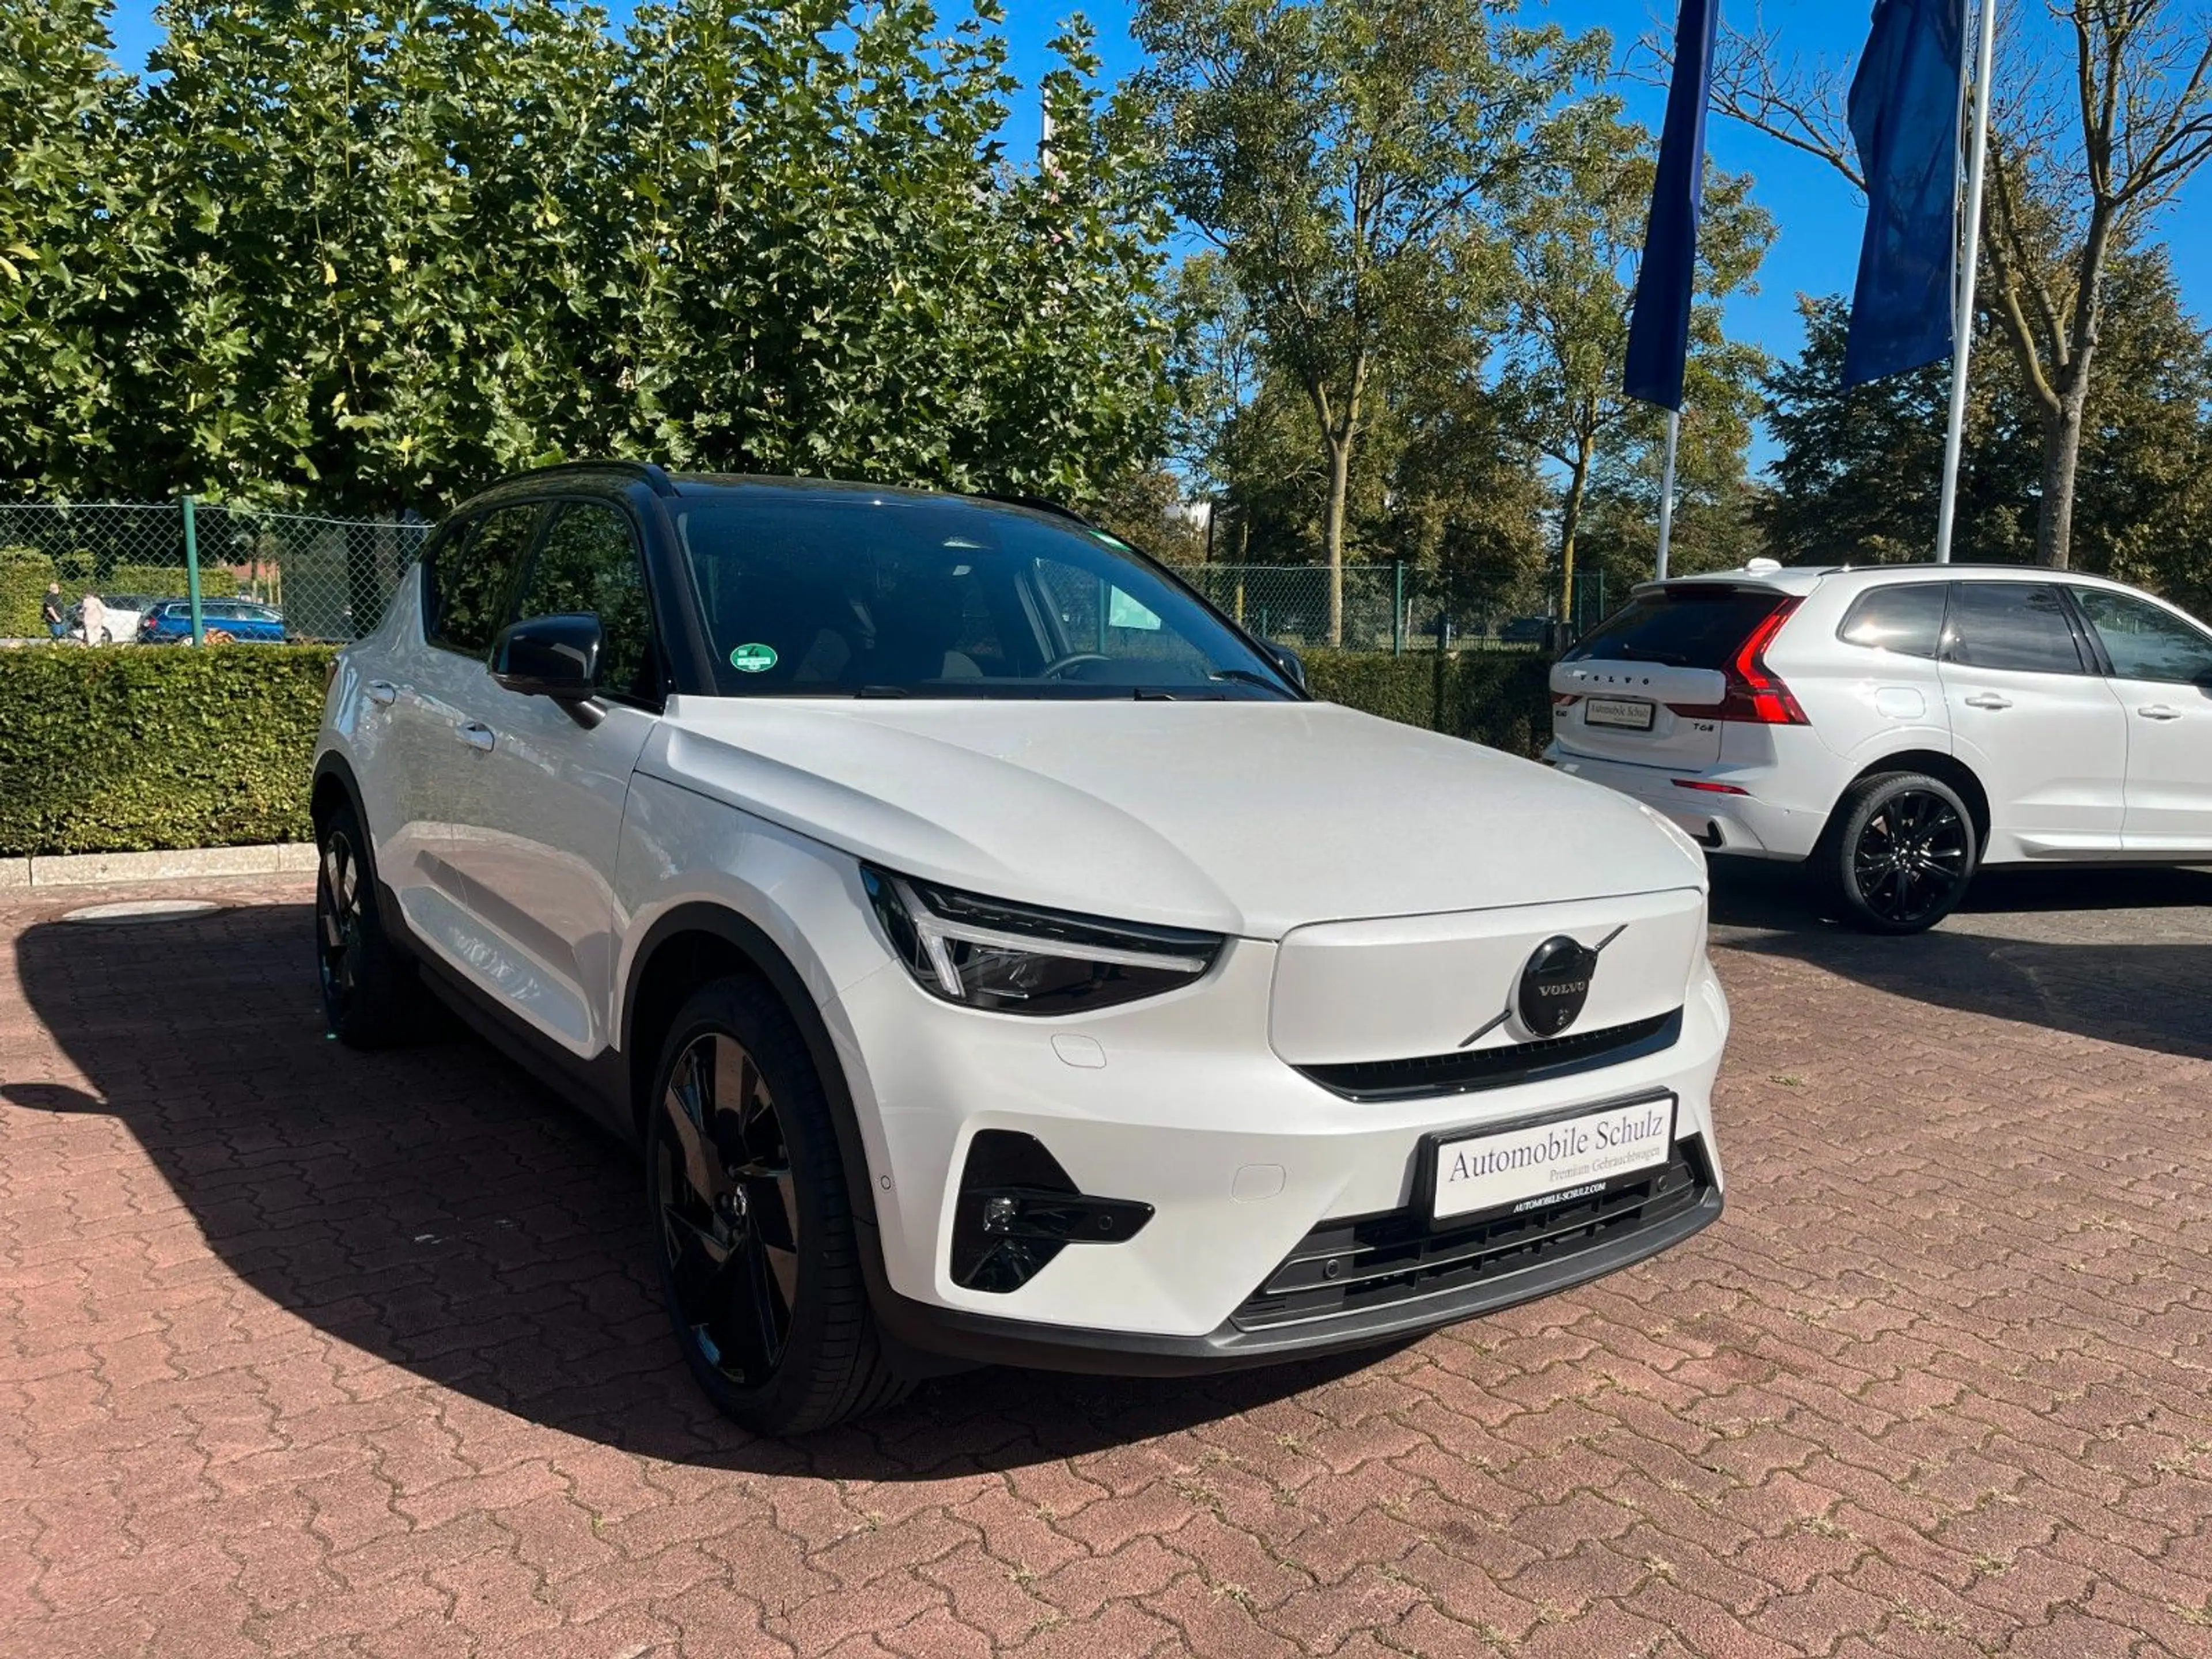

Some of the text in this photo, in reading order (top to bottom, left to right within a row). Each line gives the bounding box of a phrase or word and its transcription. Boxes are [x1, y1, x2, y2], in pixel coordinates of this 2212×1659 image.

[1580, 675, 1649, 685] VOLVO
[1539, 982, 1585, 997] VOLVO
[1448, 1110, 1664, 1181] Automobile Schulz
[1549, 1146, 1660, 1182] Premium Gebrauchtwagen
[1513, 1182, 1607, 1213] AUTOMOBILE-SCHULZ.COM
